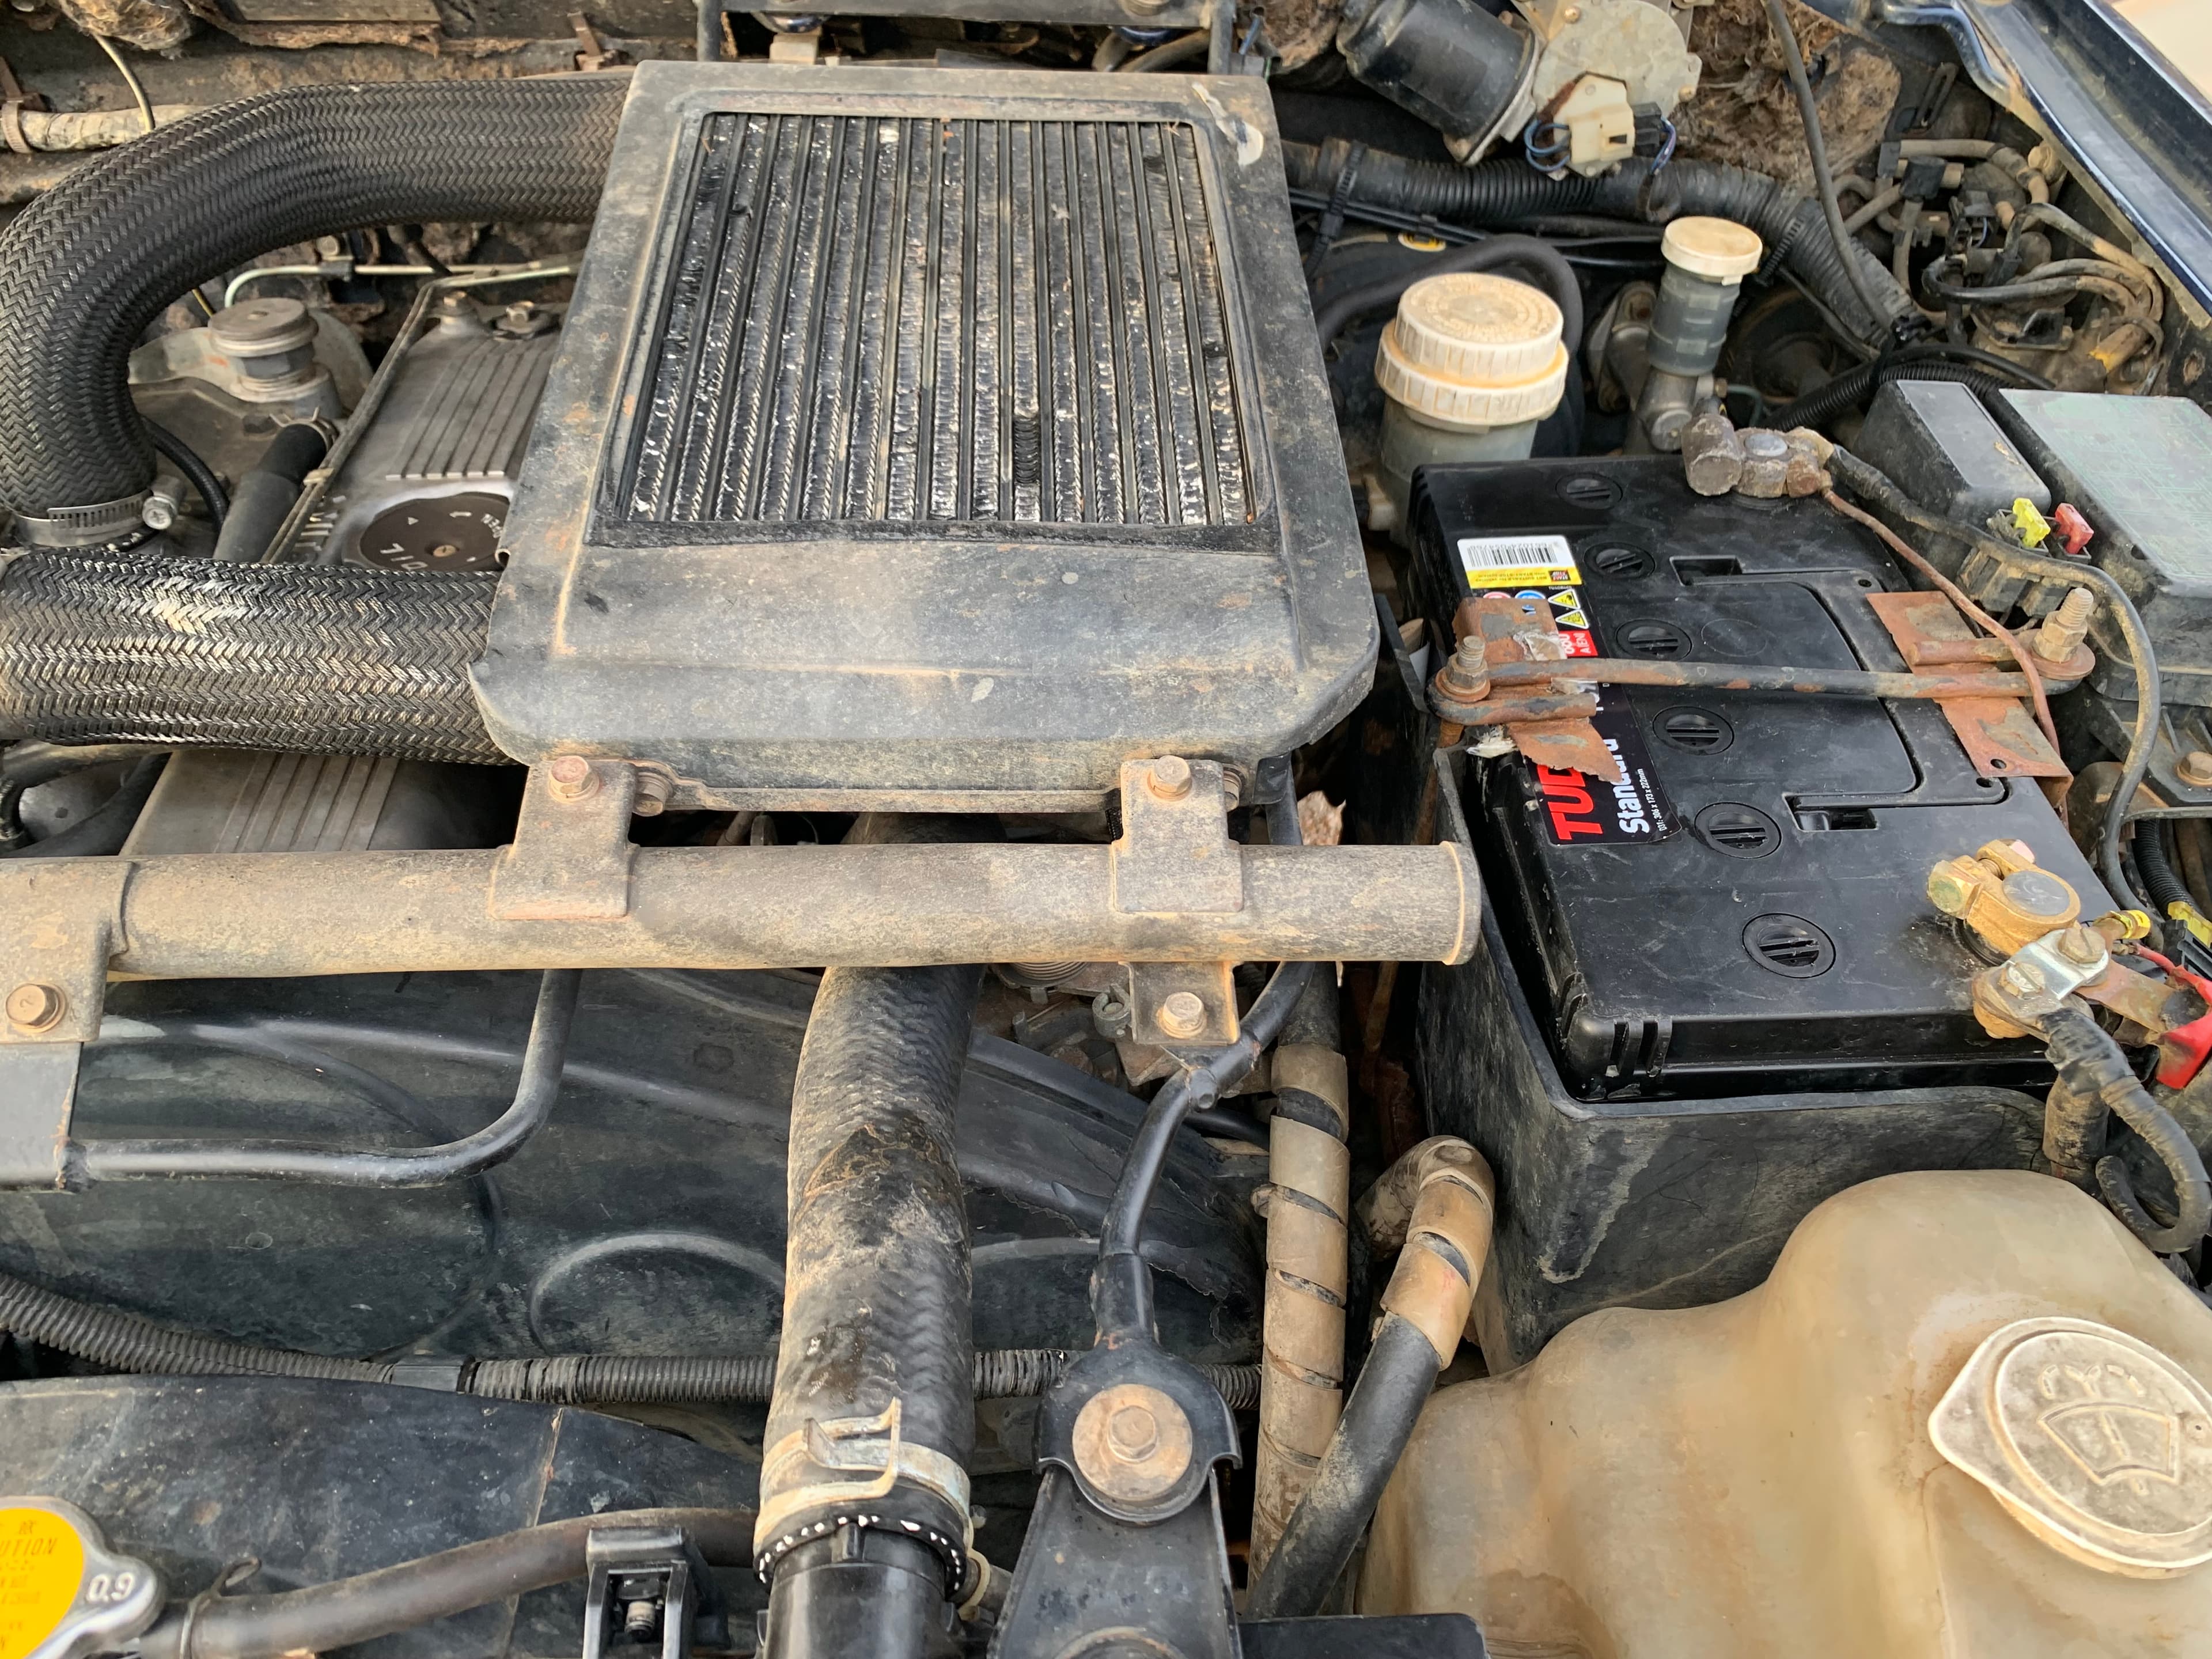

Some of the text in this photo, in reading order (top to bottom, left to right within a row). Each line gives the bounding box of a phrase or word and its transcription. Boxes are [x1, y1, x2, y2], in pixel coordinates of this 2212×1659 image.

[1637, 768, 1650, 789] 222mm
[1645, 793, 1656, 804] 173
[1652, 808, 1662, 820] 306
[86, 1571, 136, 1603] 0.9
